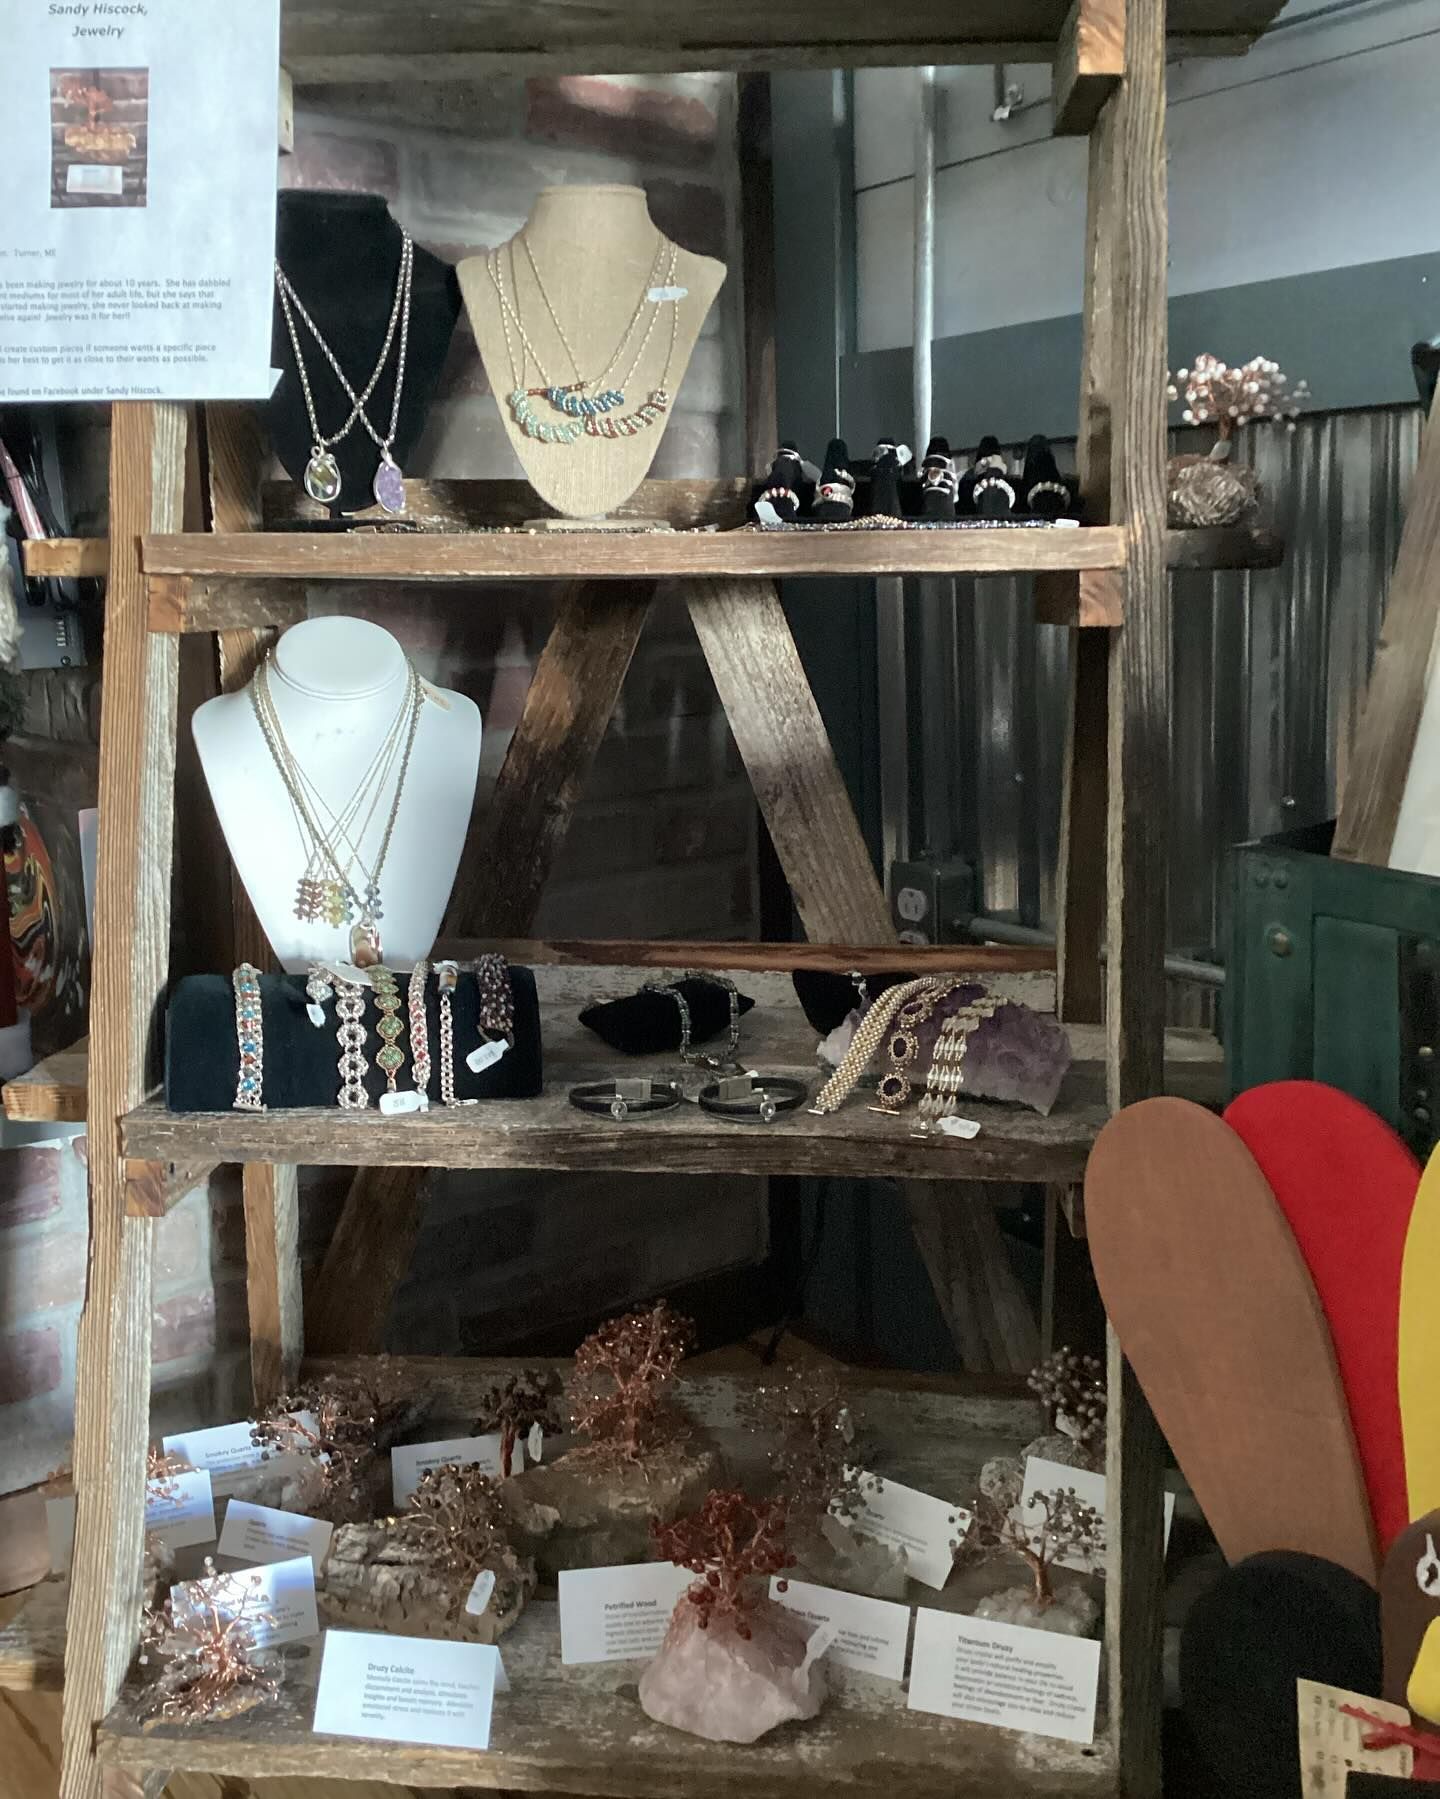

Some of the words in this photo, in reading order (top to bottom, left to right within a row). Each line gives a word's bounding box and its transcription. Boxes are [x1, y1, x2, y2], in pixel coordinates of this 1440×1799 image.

[48, 3, 89, 16] Sandy
[93, 3, 148, 16] Hiscock,
[72, 25, 125, 39] Jewelry
[105, 385, 129, 396] Sandy
[635, 1599, 657, 1608] Wood
[367, 1662, 390, 1674] Druzy
[390, 1664, 415, 1675] Calcite
